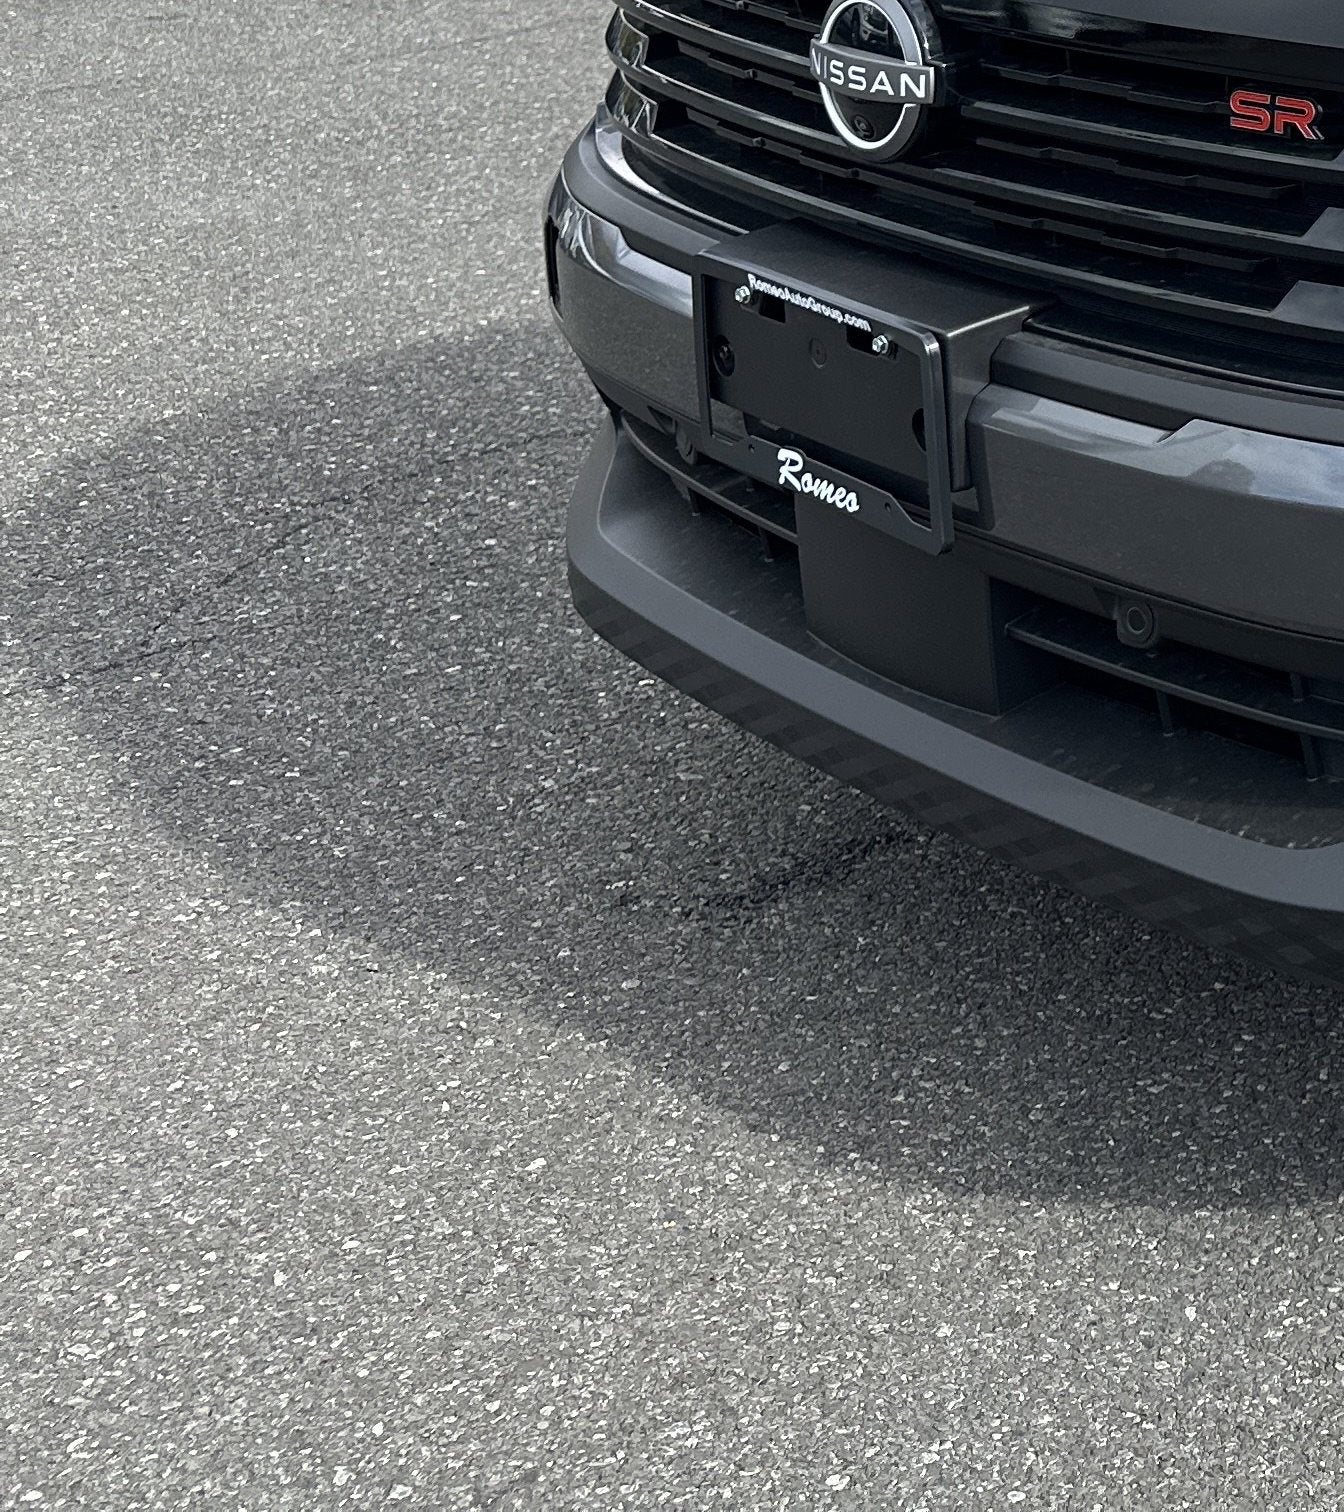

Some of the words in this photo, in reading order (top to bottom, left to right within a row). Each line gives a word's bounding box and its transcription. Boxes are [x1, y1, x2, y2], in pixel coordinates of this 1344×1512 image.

[811, 48, 926, 98] NISSAN
[1229, 89, 1319, 140] SR
[777, 448, 860, 513] Romeo
